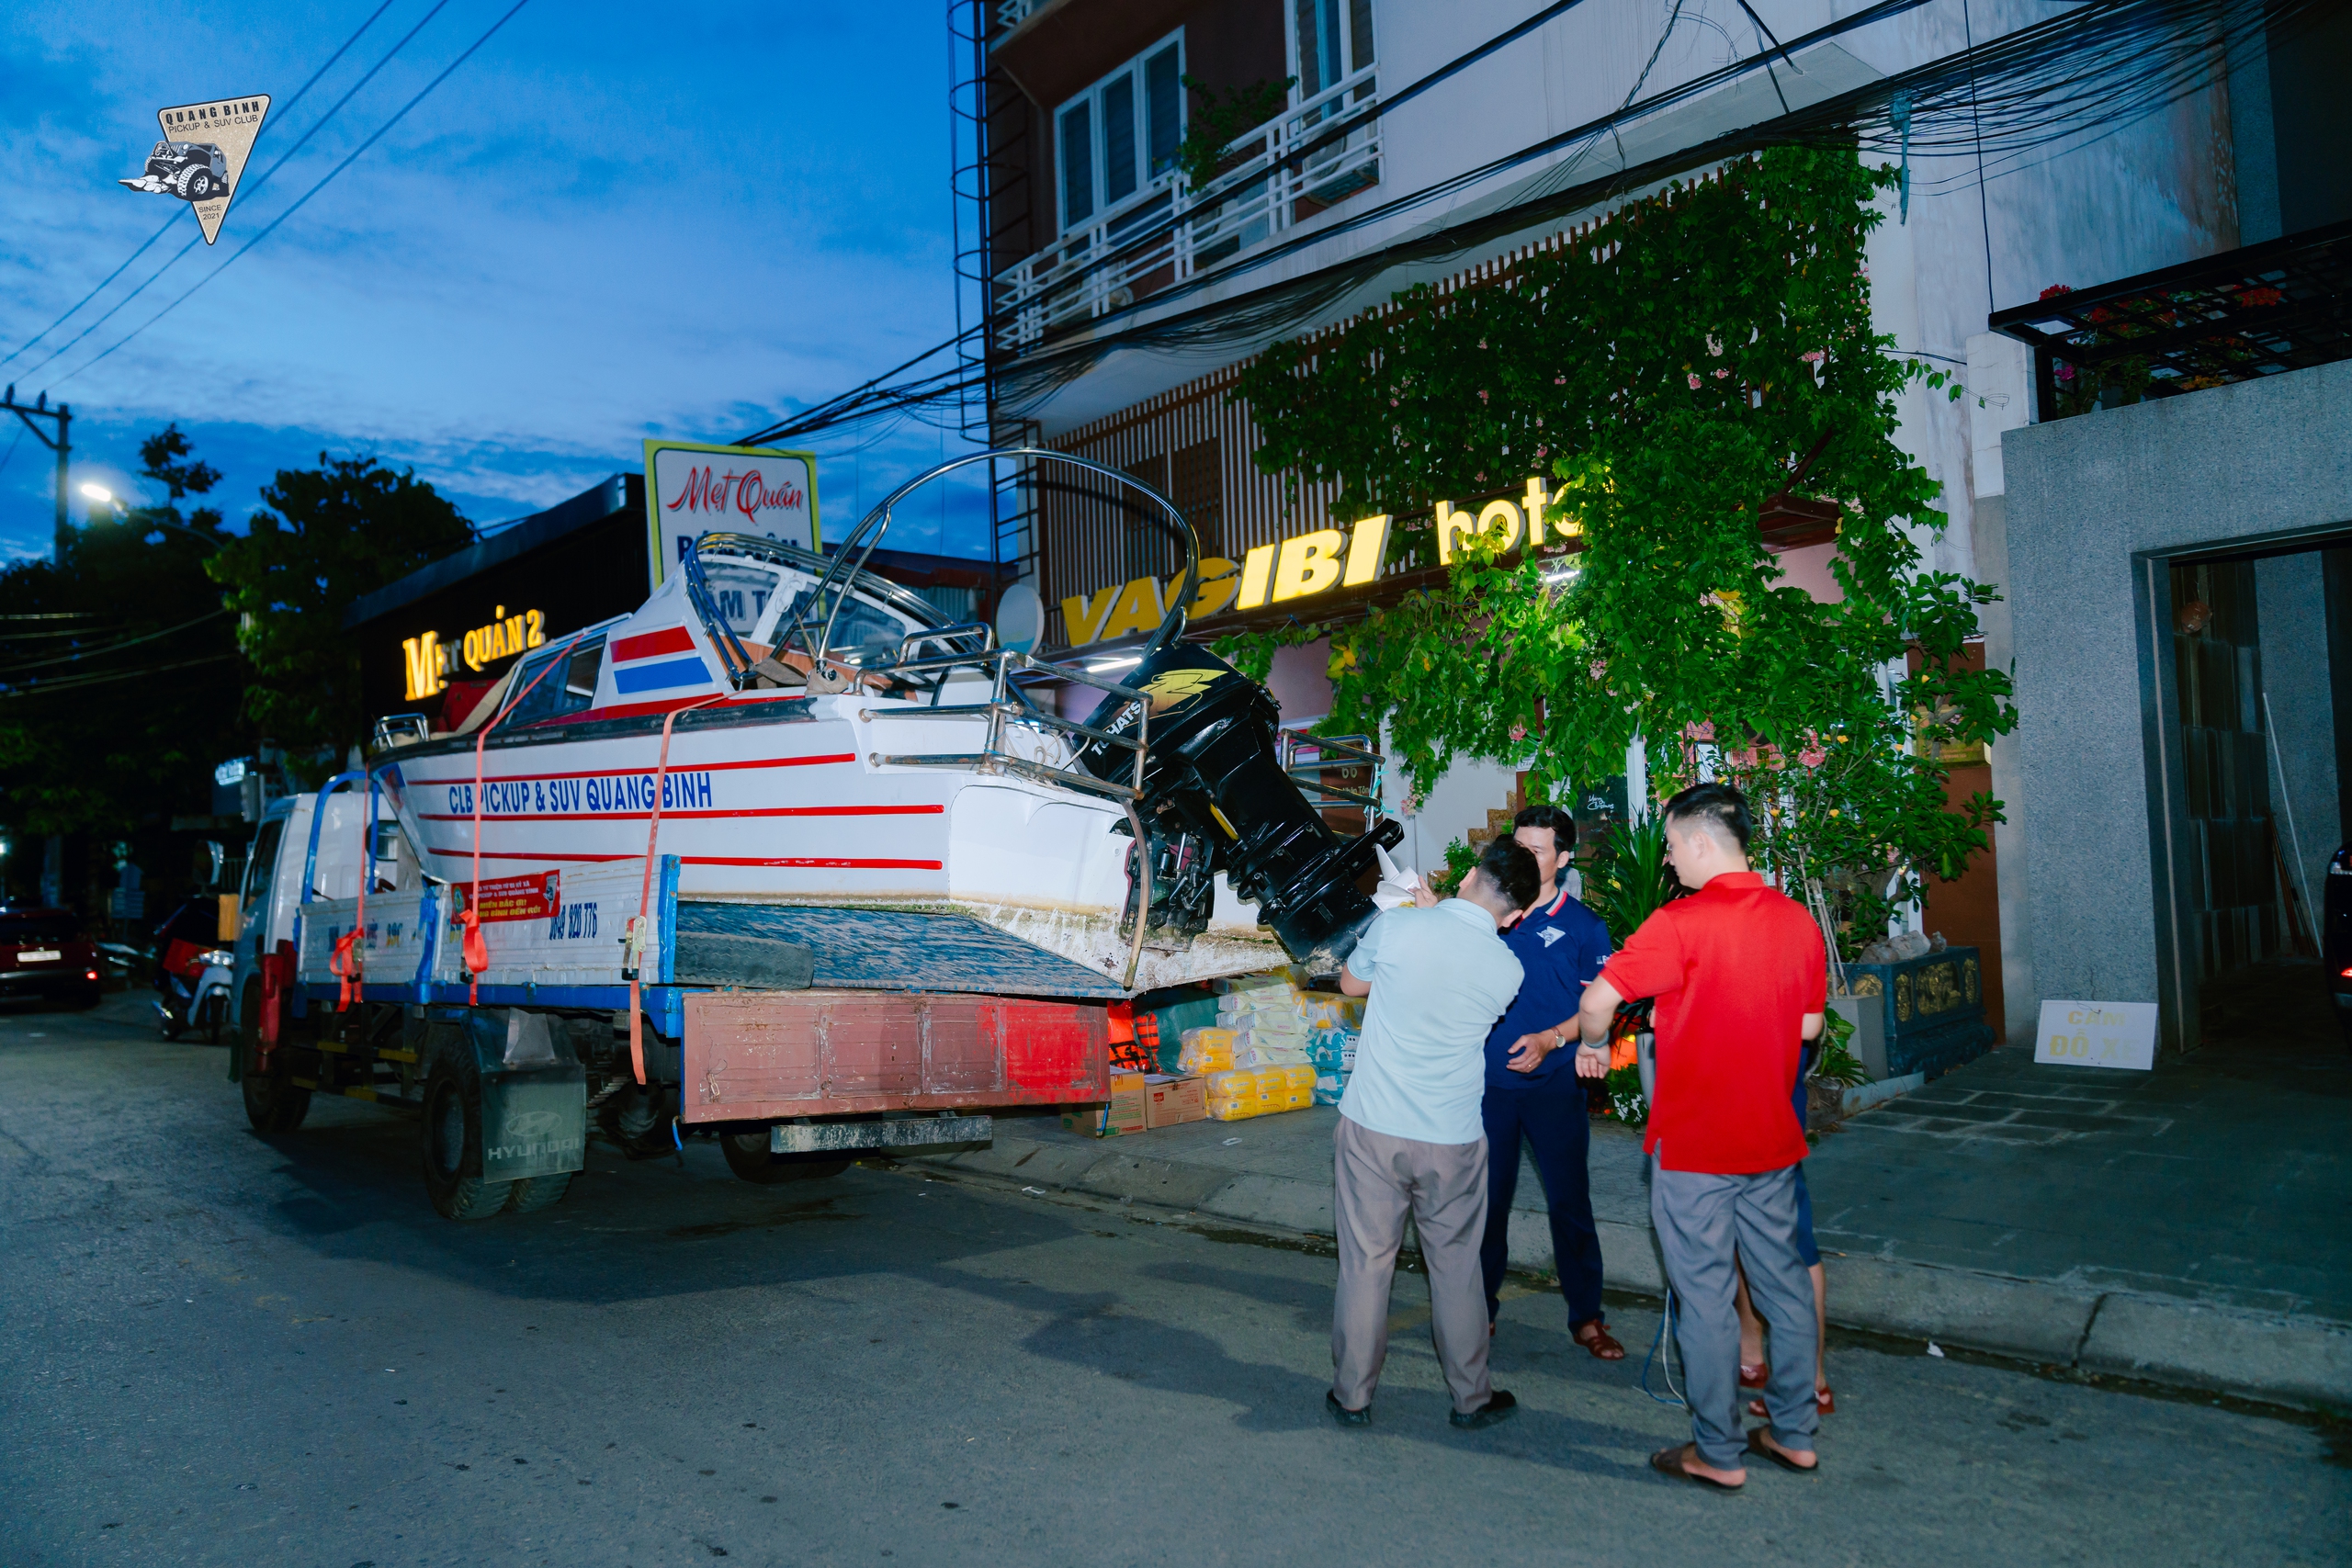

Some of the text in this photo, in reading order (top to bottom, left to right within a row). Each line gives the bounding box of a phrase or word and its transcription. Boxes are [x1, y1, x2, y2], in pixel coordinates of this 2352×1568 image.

[667, 466, 803, 525] Mẹt Quán
[1436, 476, 1614, 567] hot
[463, 604, 526, 672] QUÁN
[526, 609, 546, 649] 2
[1091, 691, 1149, 756] THATS
[448, 784, 474, 814] CLB
[535, 781, 546, 812] &
[549, 779, 581, 812] SUV
[586, 775, 657, 811] QUANG
[662, 772, 713, 809] BINH
[488, 1137, 580, 1161] HYUNDAI
